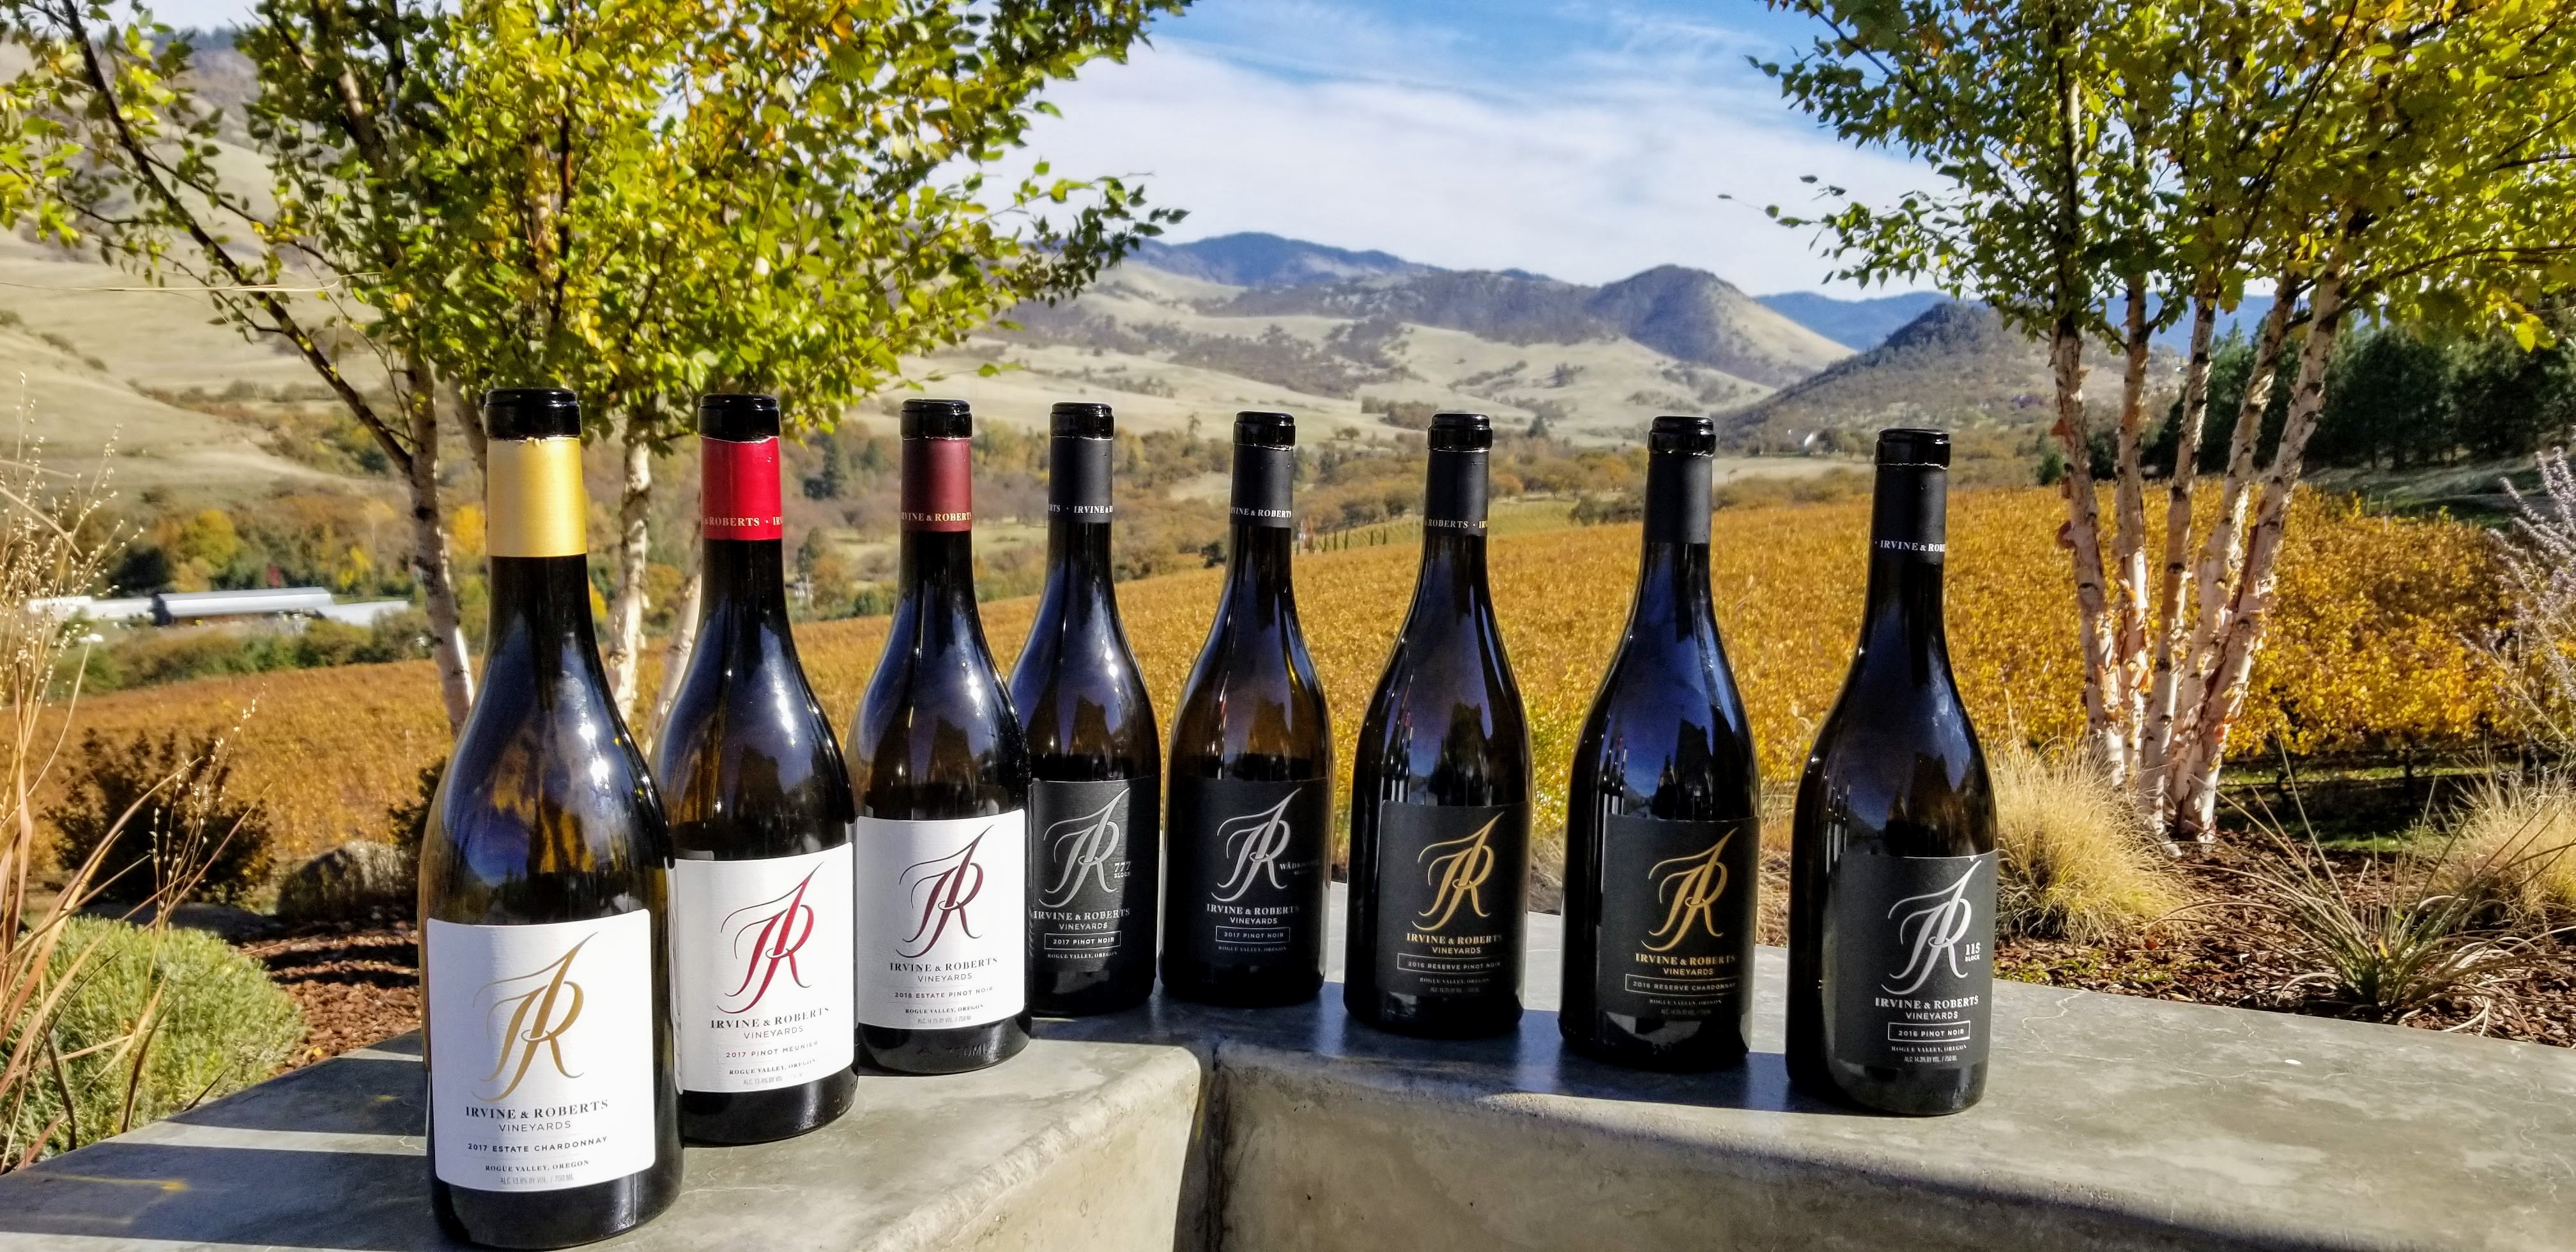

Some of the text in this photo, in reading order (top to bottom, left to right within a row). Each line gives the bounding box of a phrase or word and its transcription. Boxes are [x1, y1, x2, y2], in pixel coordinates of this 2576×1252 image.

[709, 517, 760, 526] ROBERTS
[1428, 519, 1468, 528] ROBERTS
[1880, 540, 1918, 551] IRVINE
[1115, 861, 1131, 872] 777
[1034, 911, 1072, 920] IRVINE
[1084, 908, 1130, 920] ROBERTS
[1207, 904, 1243, 914] IRVINE
[1407, 933, 1445, 943] IRVINE
[1966, 942, 1981, 955] 115
[1636, 953, 1678, 965] IRVINE
[890, 963, 931, 972] IRVINE
[918, 973, 972, 982] VINEYARDS
[1875, 998, 1920, 1009] IRVINE
[1934, 995, 1979, 1009] ROBERTS
[1906, 1011, 1958, 1019] VINEYARDS
[711, 1019, 760, 1028] IRVINE
[744, 1026, 804, 1039] VINEYARDS
[783, 1041, 818, 1053] MEUNIER
[466, 1106, 516, 1118] IRVINE
[534, 1099, 608, 1118] ROBERTS
[499, 1121, 571, 1132] VINEYARDS
[534, 1136, 606, 1151] CHARDONNAY
[553, 1160, 588, 1170] OREGON
